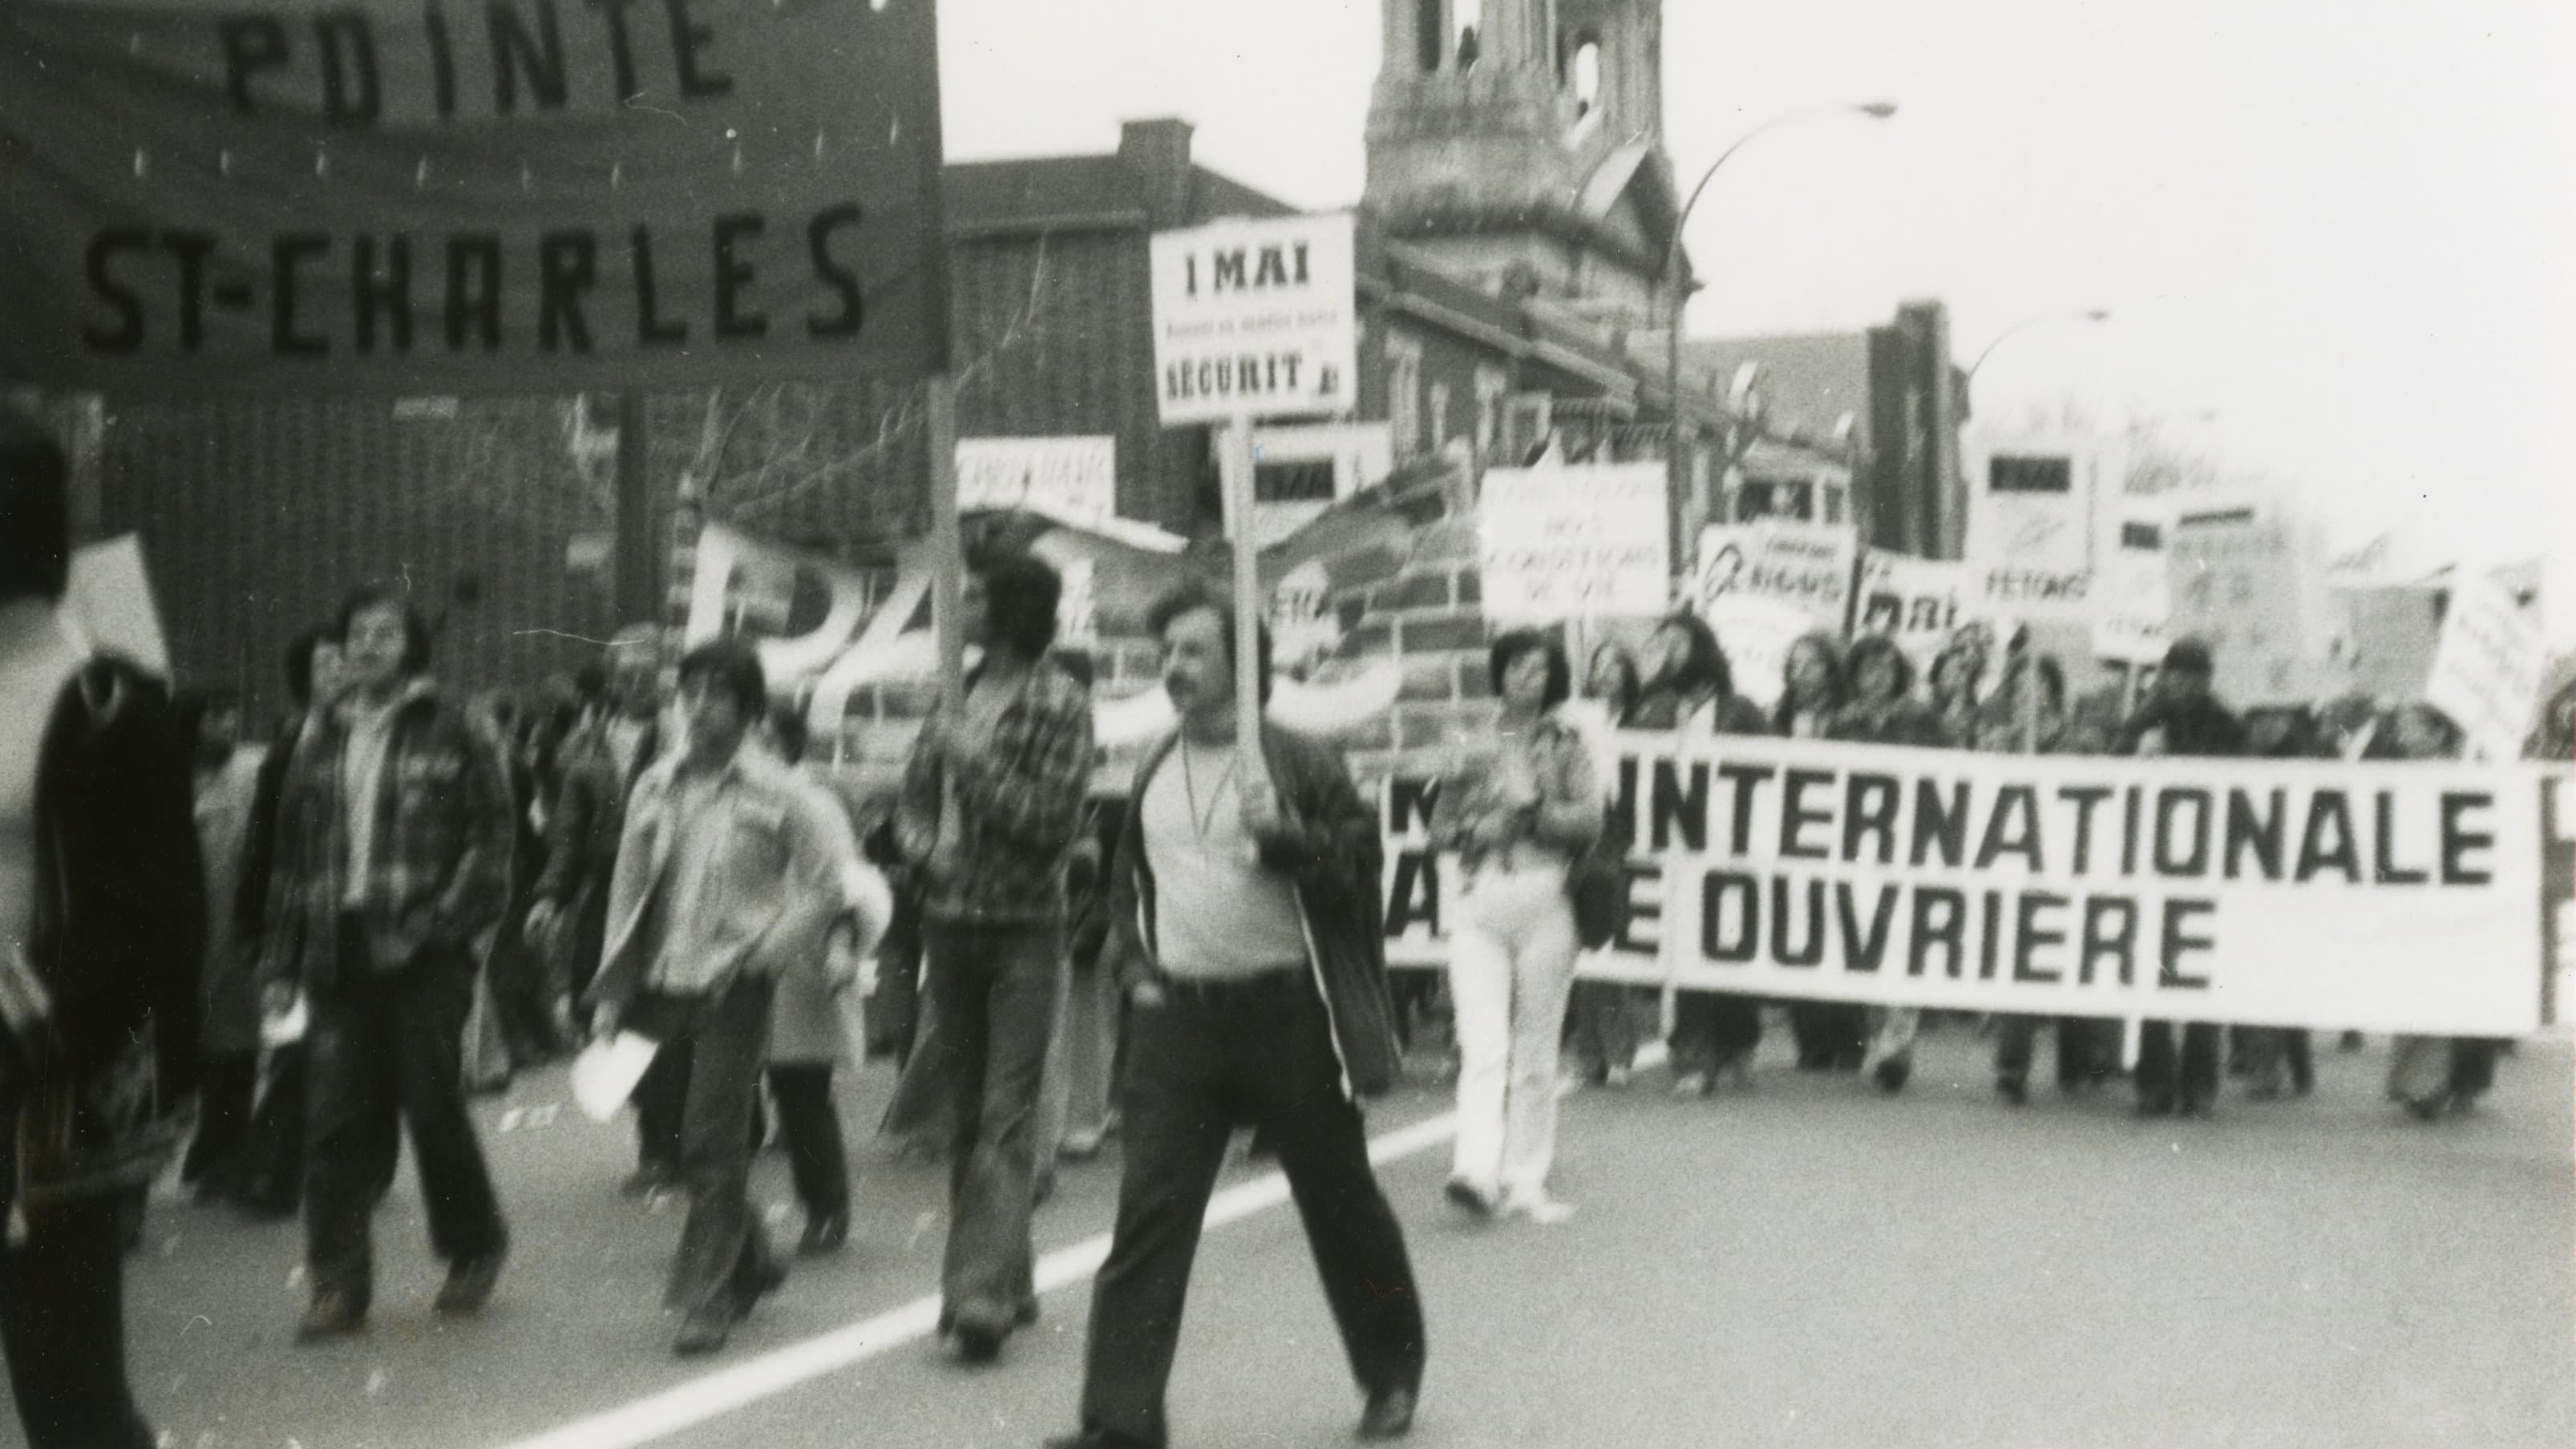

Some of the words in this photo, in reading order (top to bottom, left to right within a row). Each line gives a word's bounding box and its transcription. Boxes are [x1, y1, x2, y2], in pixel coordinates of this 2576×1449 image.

[220, 0, 733, 126] POINTE
[83, 201, 864, 354] ST-CHARLES
[1213, 242, 1309, 293] MAI
[1612, 755, 2495, 887] INTERNATIONALE
[1701, 871, 2218, 990] OUVRIERE
